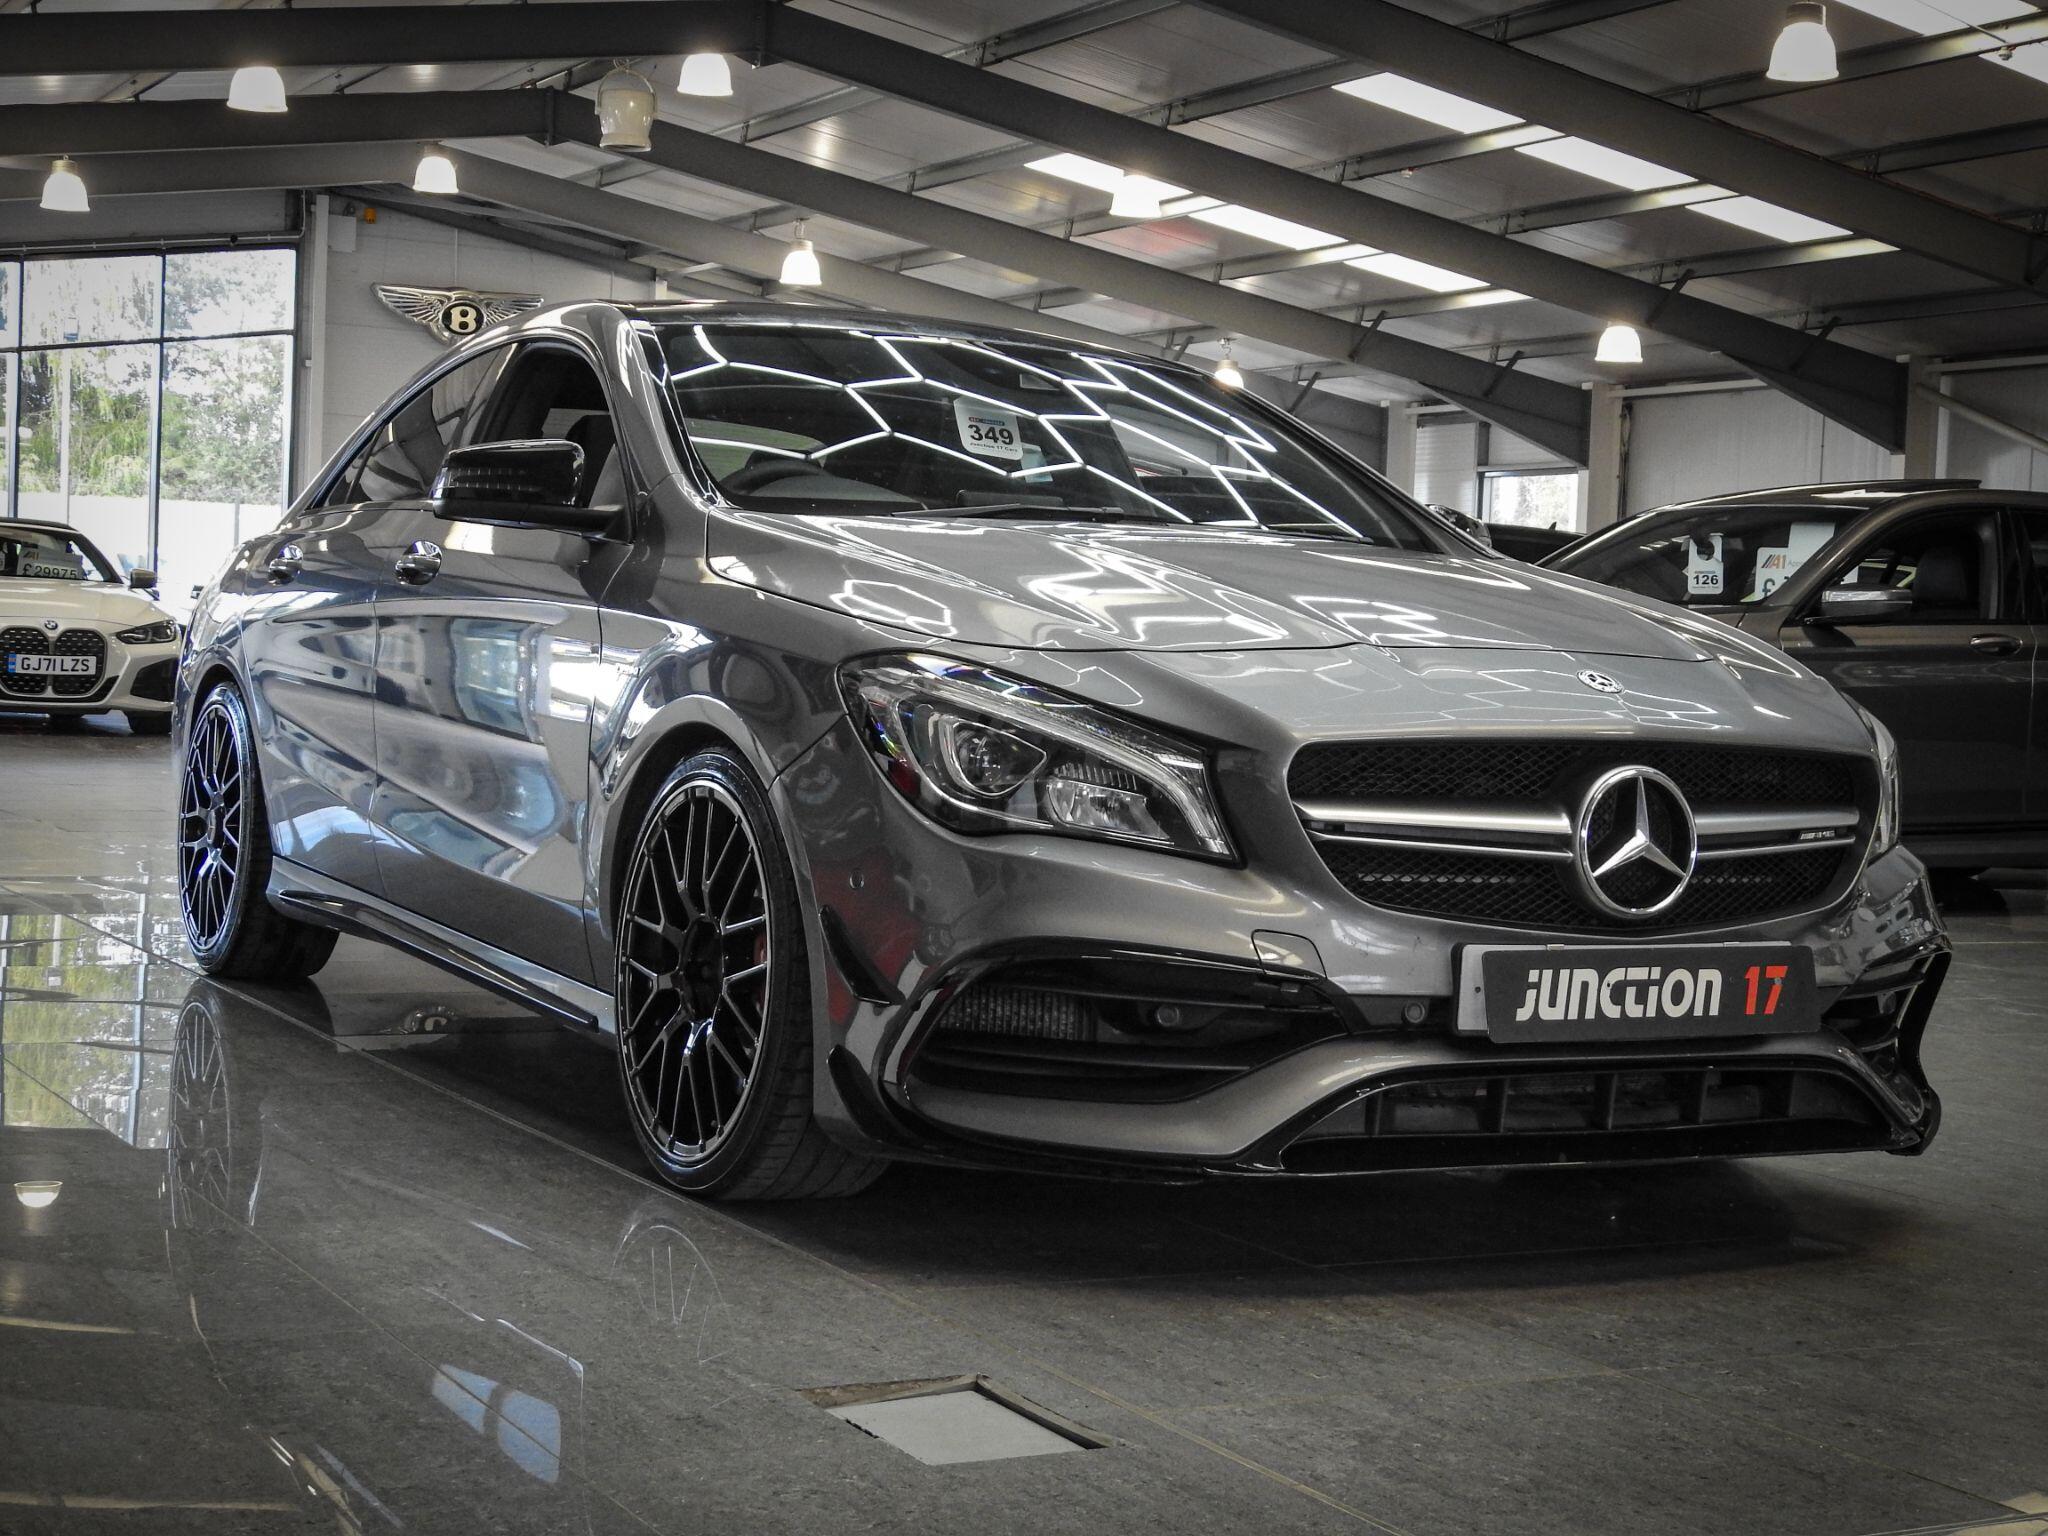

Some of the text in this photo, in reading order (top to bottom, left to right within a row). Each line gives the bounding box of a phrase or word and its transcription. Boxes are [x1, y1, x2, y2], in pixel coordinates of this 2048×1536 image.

[450, 306, 477, 333] B
[968, 424, 1014, 446] 349
[1693, 574, 1719, 585] 126
[21, 657, 57, 672] GJ71
[60, 658, 90, 672] LZS
[1744, 965, 1788, 1015] 17
